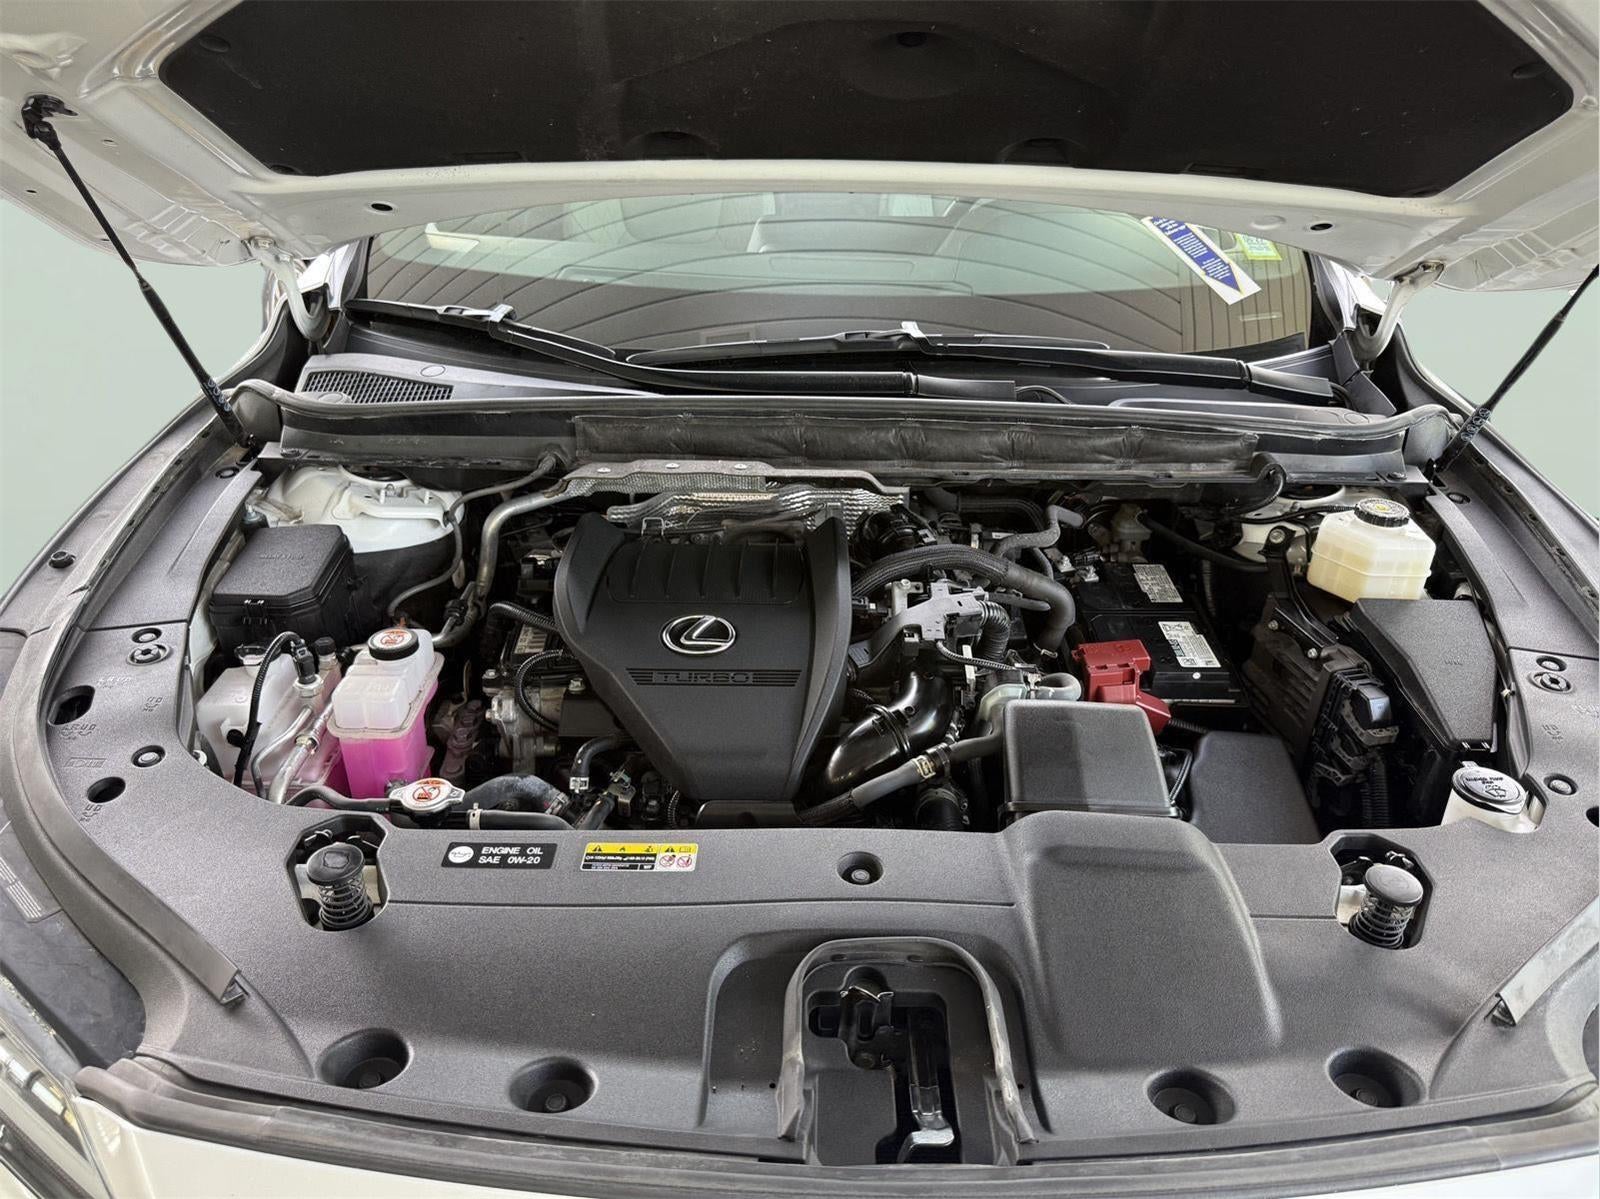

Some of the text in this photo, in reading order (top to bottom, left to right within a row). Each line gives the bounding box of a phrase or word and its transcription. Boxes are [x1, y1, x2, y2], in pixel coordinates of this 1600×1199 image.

[656, 672, 750, 683] TURBO
[481, 846, 544, 855] ENGINE OIL
[478, 856, 541, 864] SAE 0W-20
